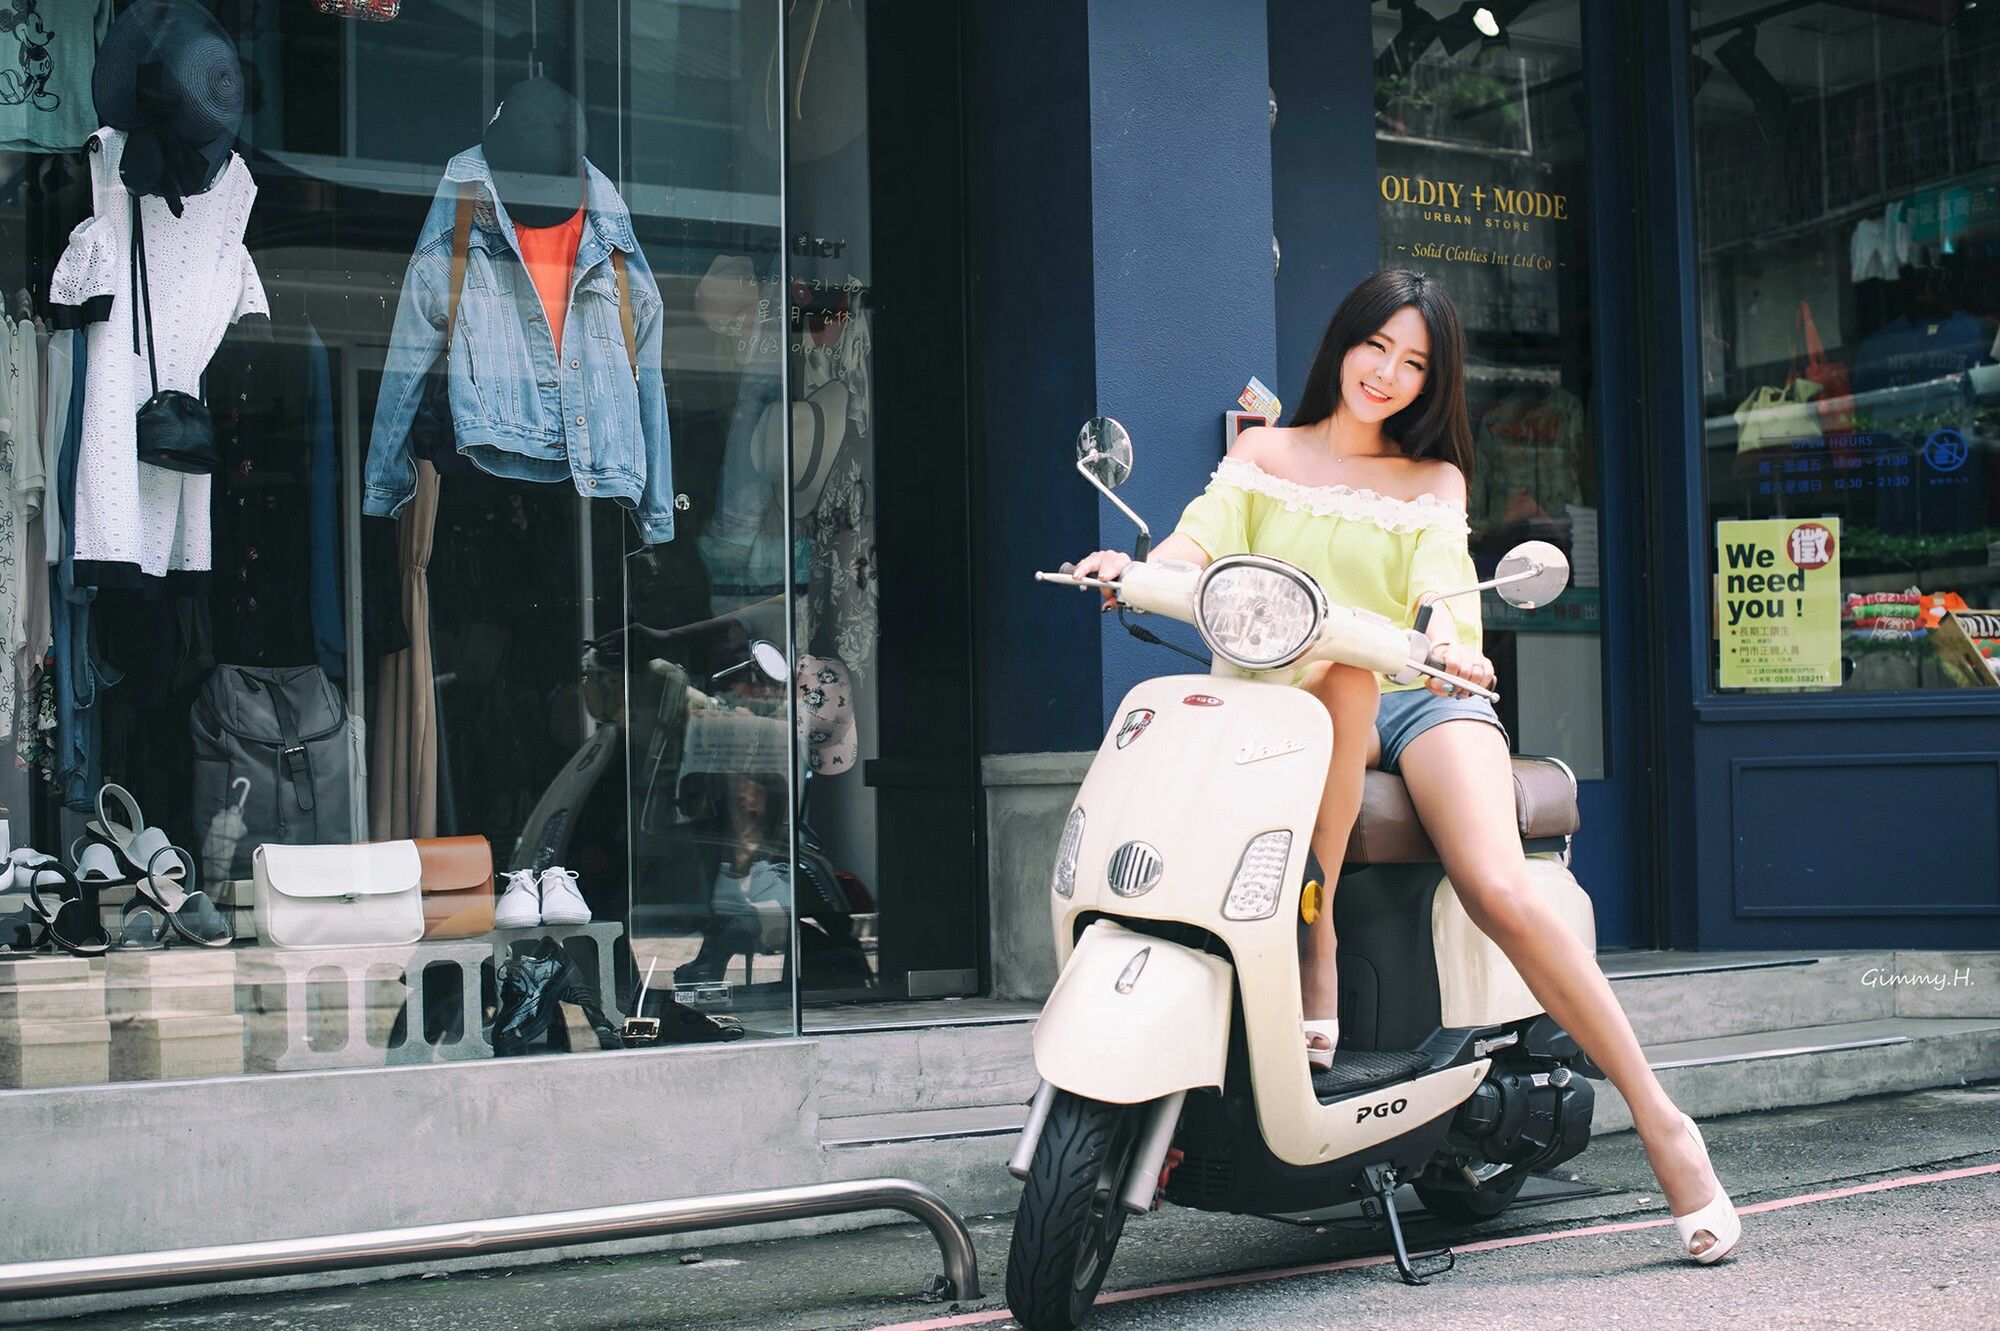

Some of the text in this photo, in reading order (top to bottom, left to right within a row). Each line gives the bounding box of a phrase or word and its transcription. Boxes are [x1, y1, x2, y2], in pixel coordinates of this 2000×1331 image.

[1380, 174, 1464, 209] OLDIY
[1493, 187, 1568, 220] MODE
[1423, 211, 1530, 232] URBAN STORE
[1411, 242, 1442, 258] Solid
[1445, 245, 1488, 264] Clothes
[1491, 250, 1509, 265] Int
[1512, 252, 1534, 268] Ltd
[1536, 255, 1552, 271] Co
[1791, 435, 1873, 449] OPEN HOURS
[1726, 543, 1775, 569] We
[1728, 568, 1806, 593] need
[1728, 598, 1785, 626] you
[1355, 1097, 1408, 1124] PGO
